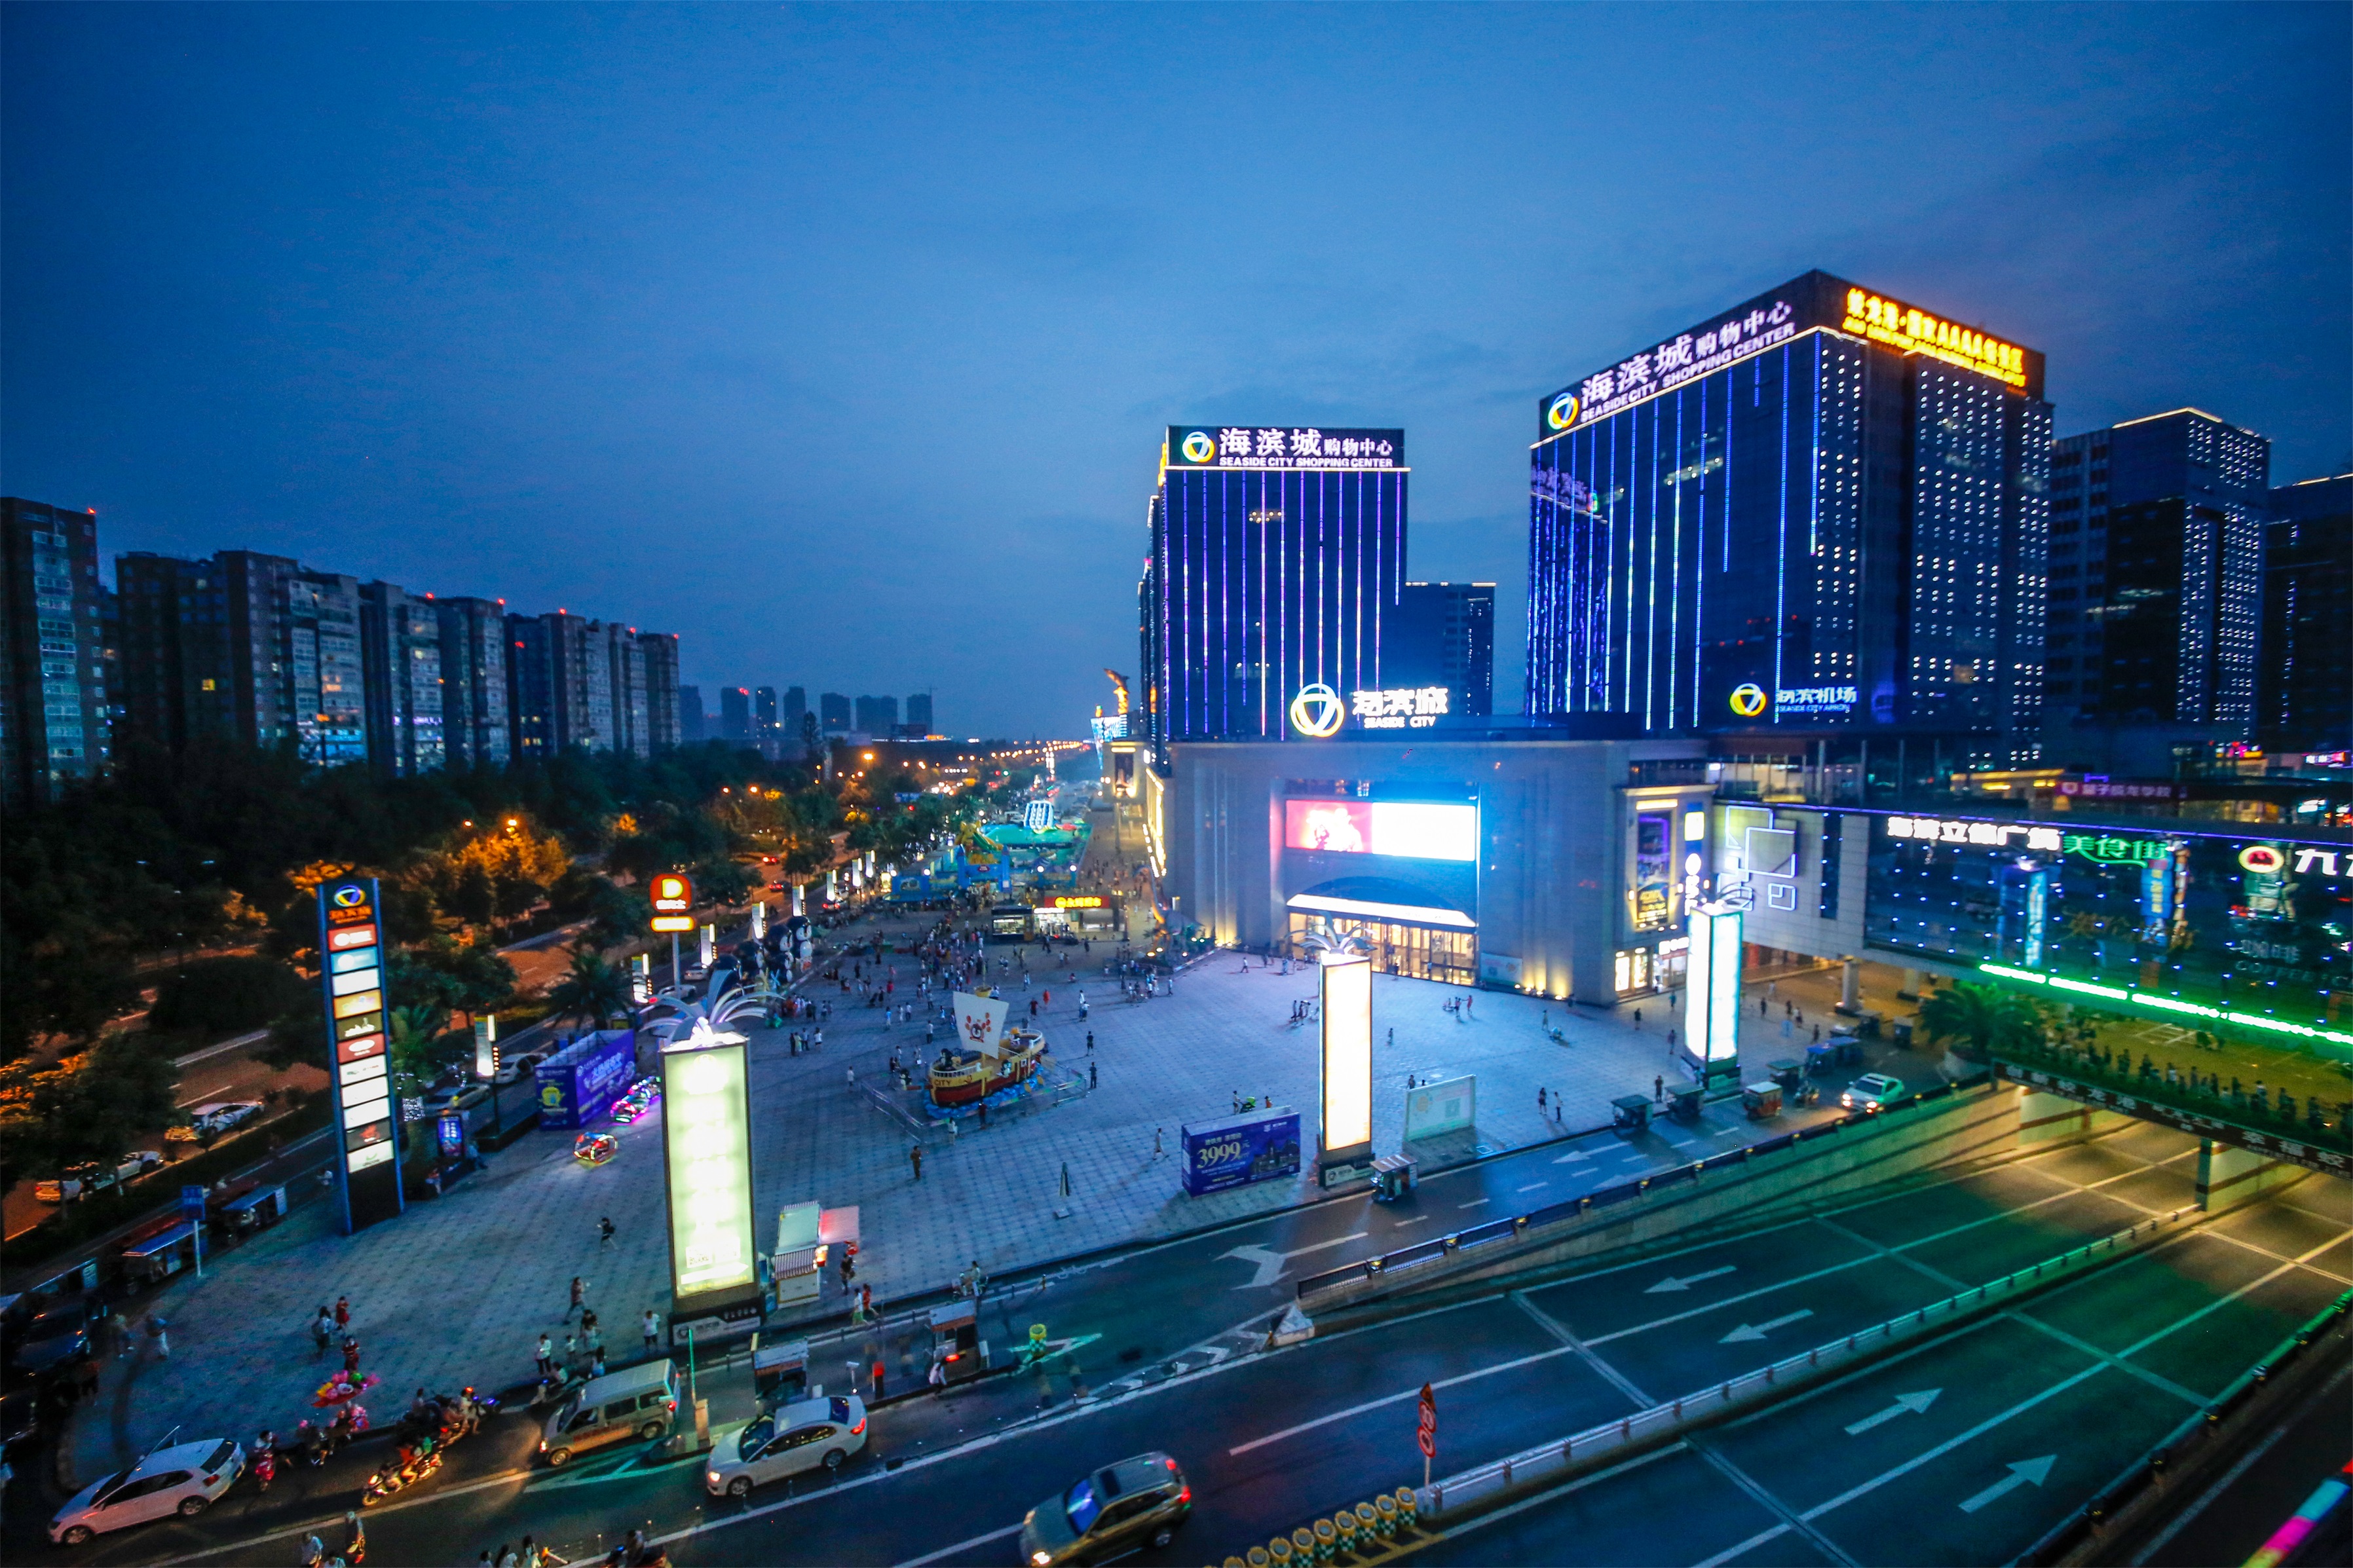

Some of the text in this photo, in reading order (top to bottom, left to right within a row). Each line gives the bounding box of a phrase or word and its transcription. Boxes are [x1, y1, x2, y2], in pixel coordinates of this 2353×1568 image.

[1581, 322, 1796, 423] SEASIDE CITY SHOPPING CENTER
[1219, 457, 1393, 468] SEASIDE CITY SHOPPING CENTER
[1364, 716, 1436, 728] SEASIDE CITY
[1807, 704, 1823, 713] CITY
[2063, 834, 2169, 868] 美食街
[2295, 849, 2353, 878] 九
[1196, 1142, 1241, 1169] 3999
